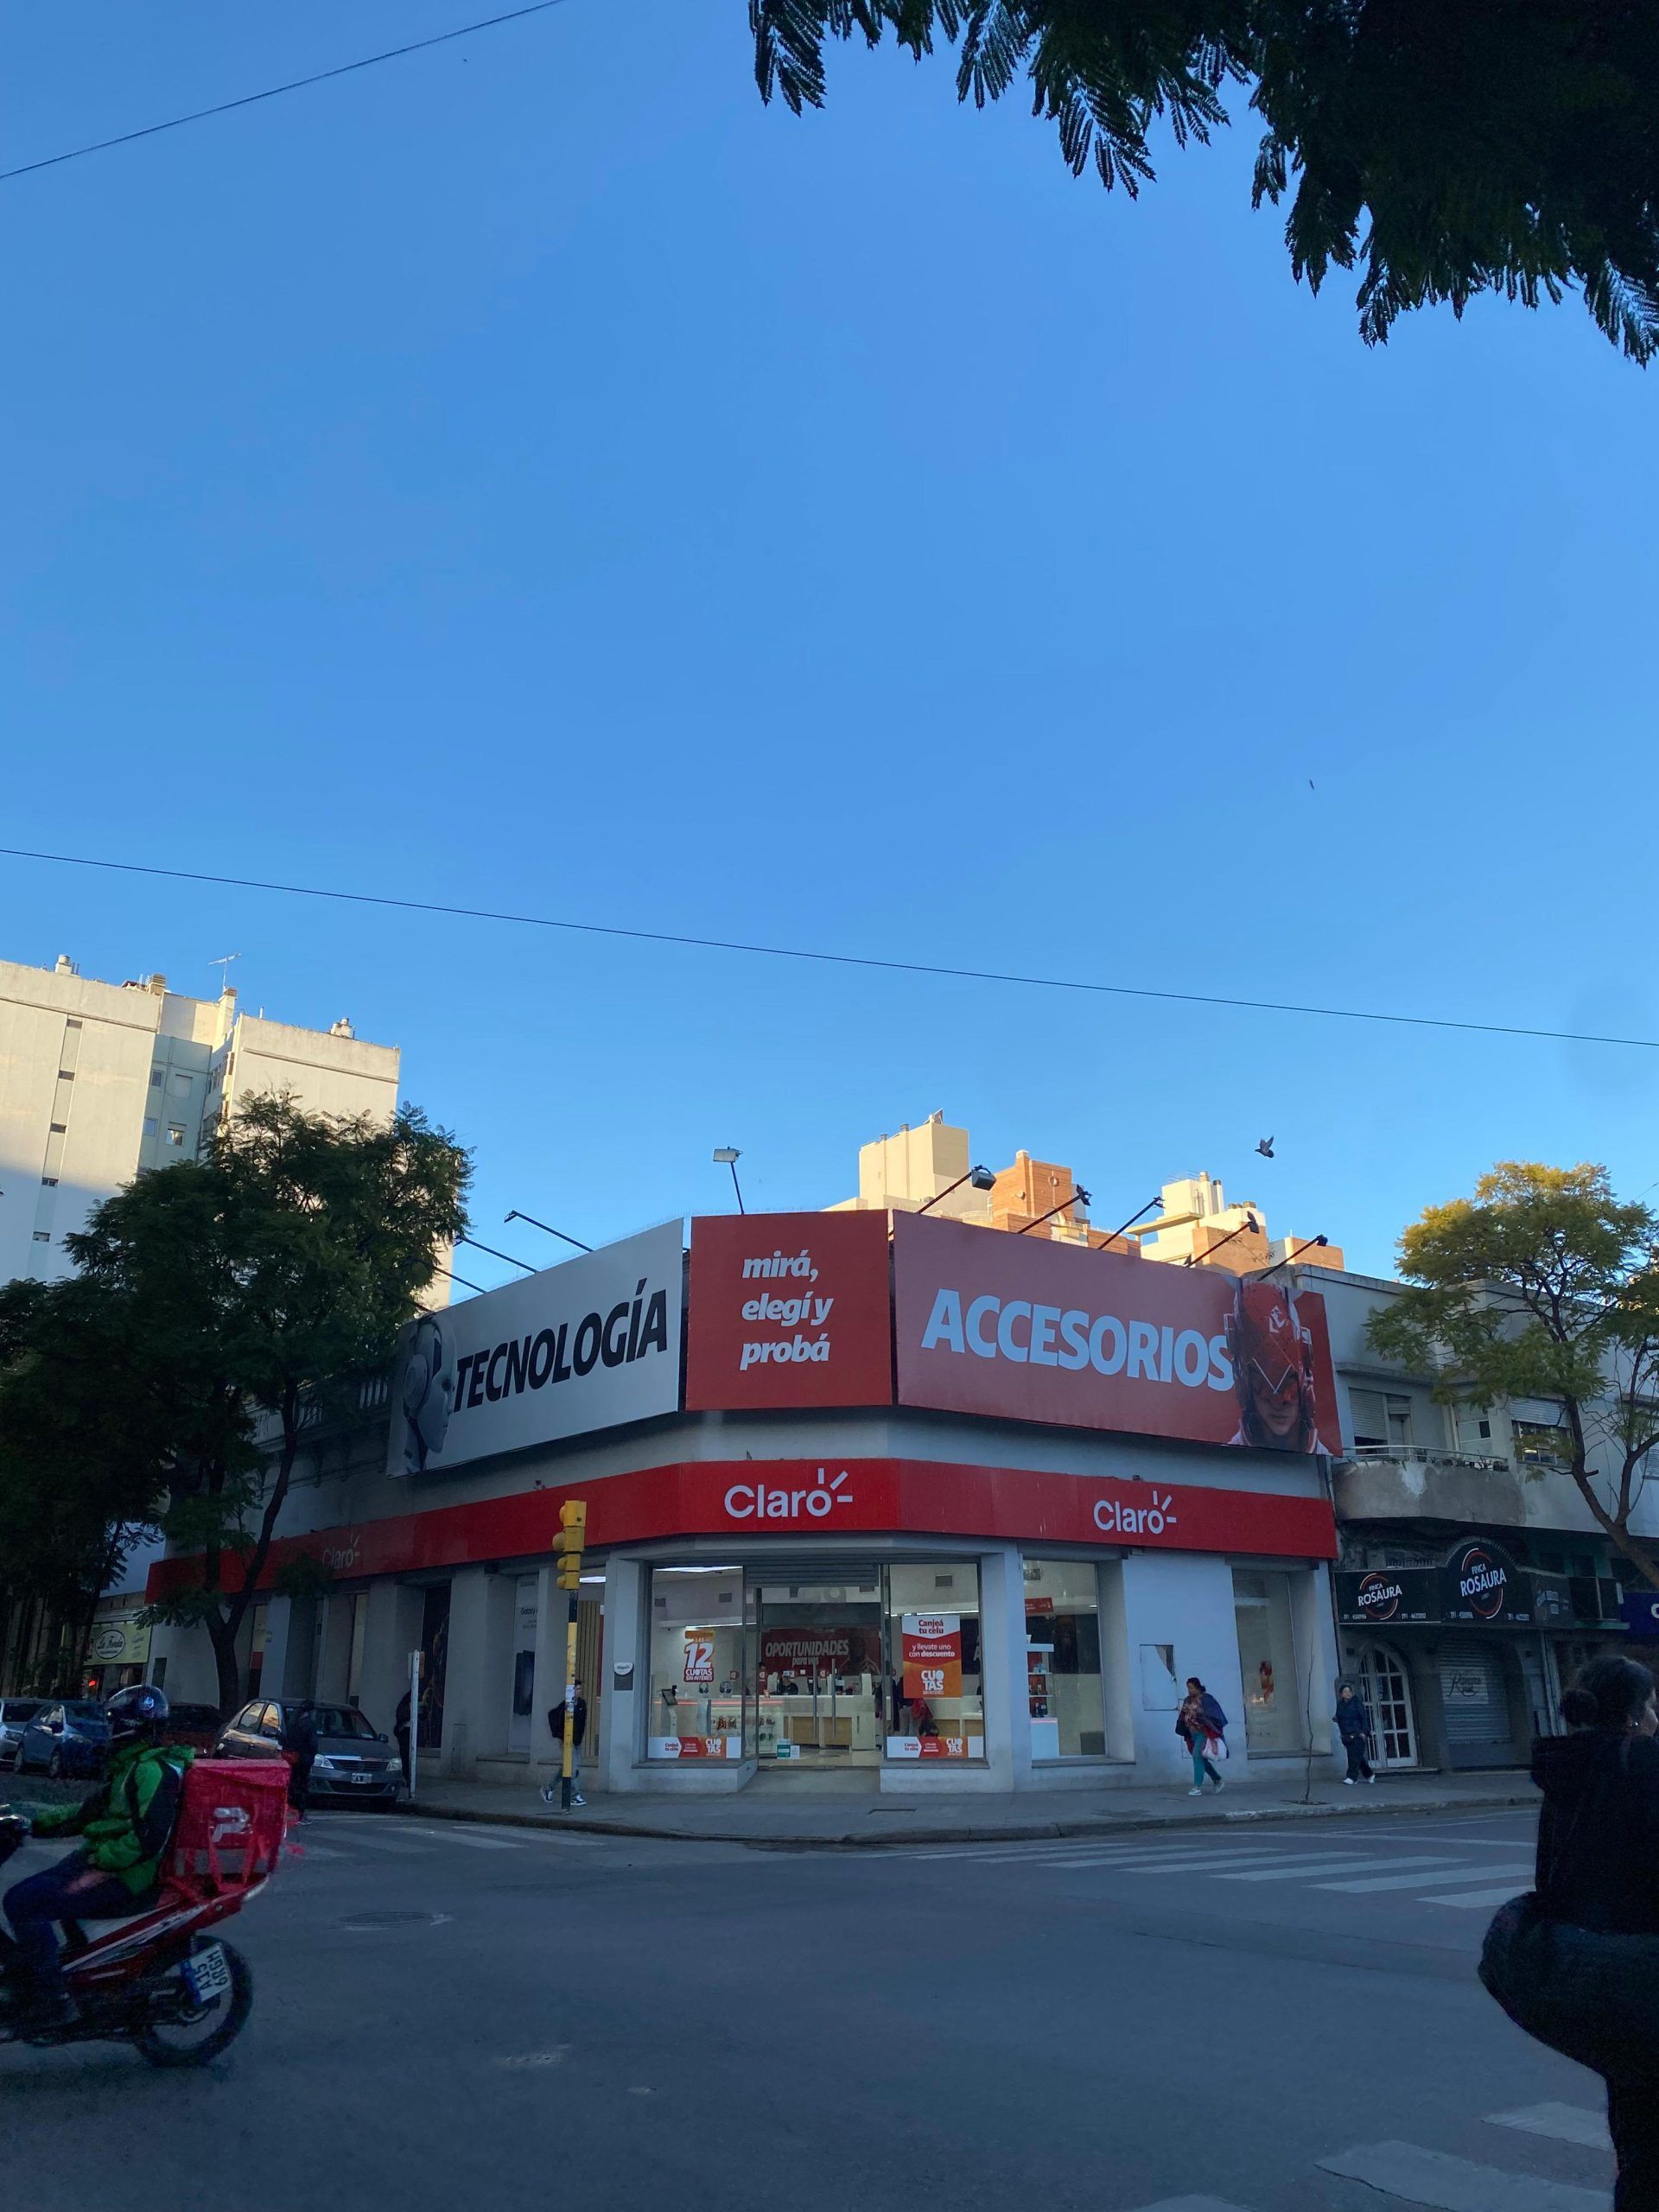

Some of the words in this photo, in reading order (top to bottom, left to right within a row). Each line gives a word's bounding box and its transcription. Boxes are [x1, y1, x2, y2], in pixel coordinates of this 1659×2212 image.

[741, 1249, 819, 1282] mirá,
[741, 1291, 814, 1326] elegí
[810, 1298, 835, 1325] y
[454, 1277, 667, 1414] TECNOLOGÍA
[739, 1333, 831, 1371] probá
[921, 1287, 1236, 1392] ACCESORIOS
[724, 1484, 833, 1519] Claro
[1093, 1499, 1165, 1535] Claro
[322, 1546, 354, 1570] Claro
[1471, 1562, 1487, 1575] FINCA
[1459, 1567, 1508, 1598] ROSAURA
[1357, 1584, 1403, 1607] ROSAURA
[918, 1619, 944, 1630] Canjeá
[929, 1625, 944, 1634] celu
[685, 1643, 714, 1669] 12
[766, 1639, 849, 1657] OPORTUNIDADES
[791, 1657, 808, 1668] para
[921, 1670, 944, 1681] CUO
[923, 1680, 944, 1691] TAS
